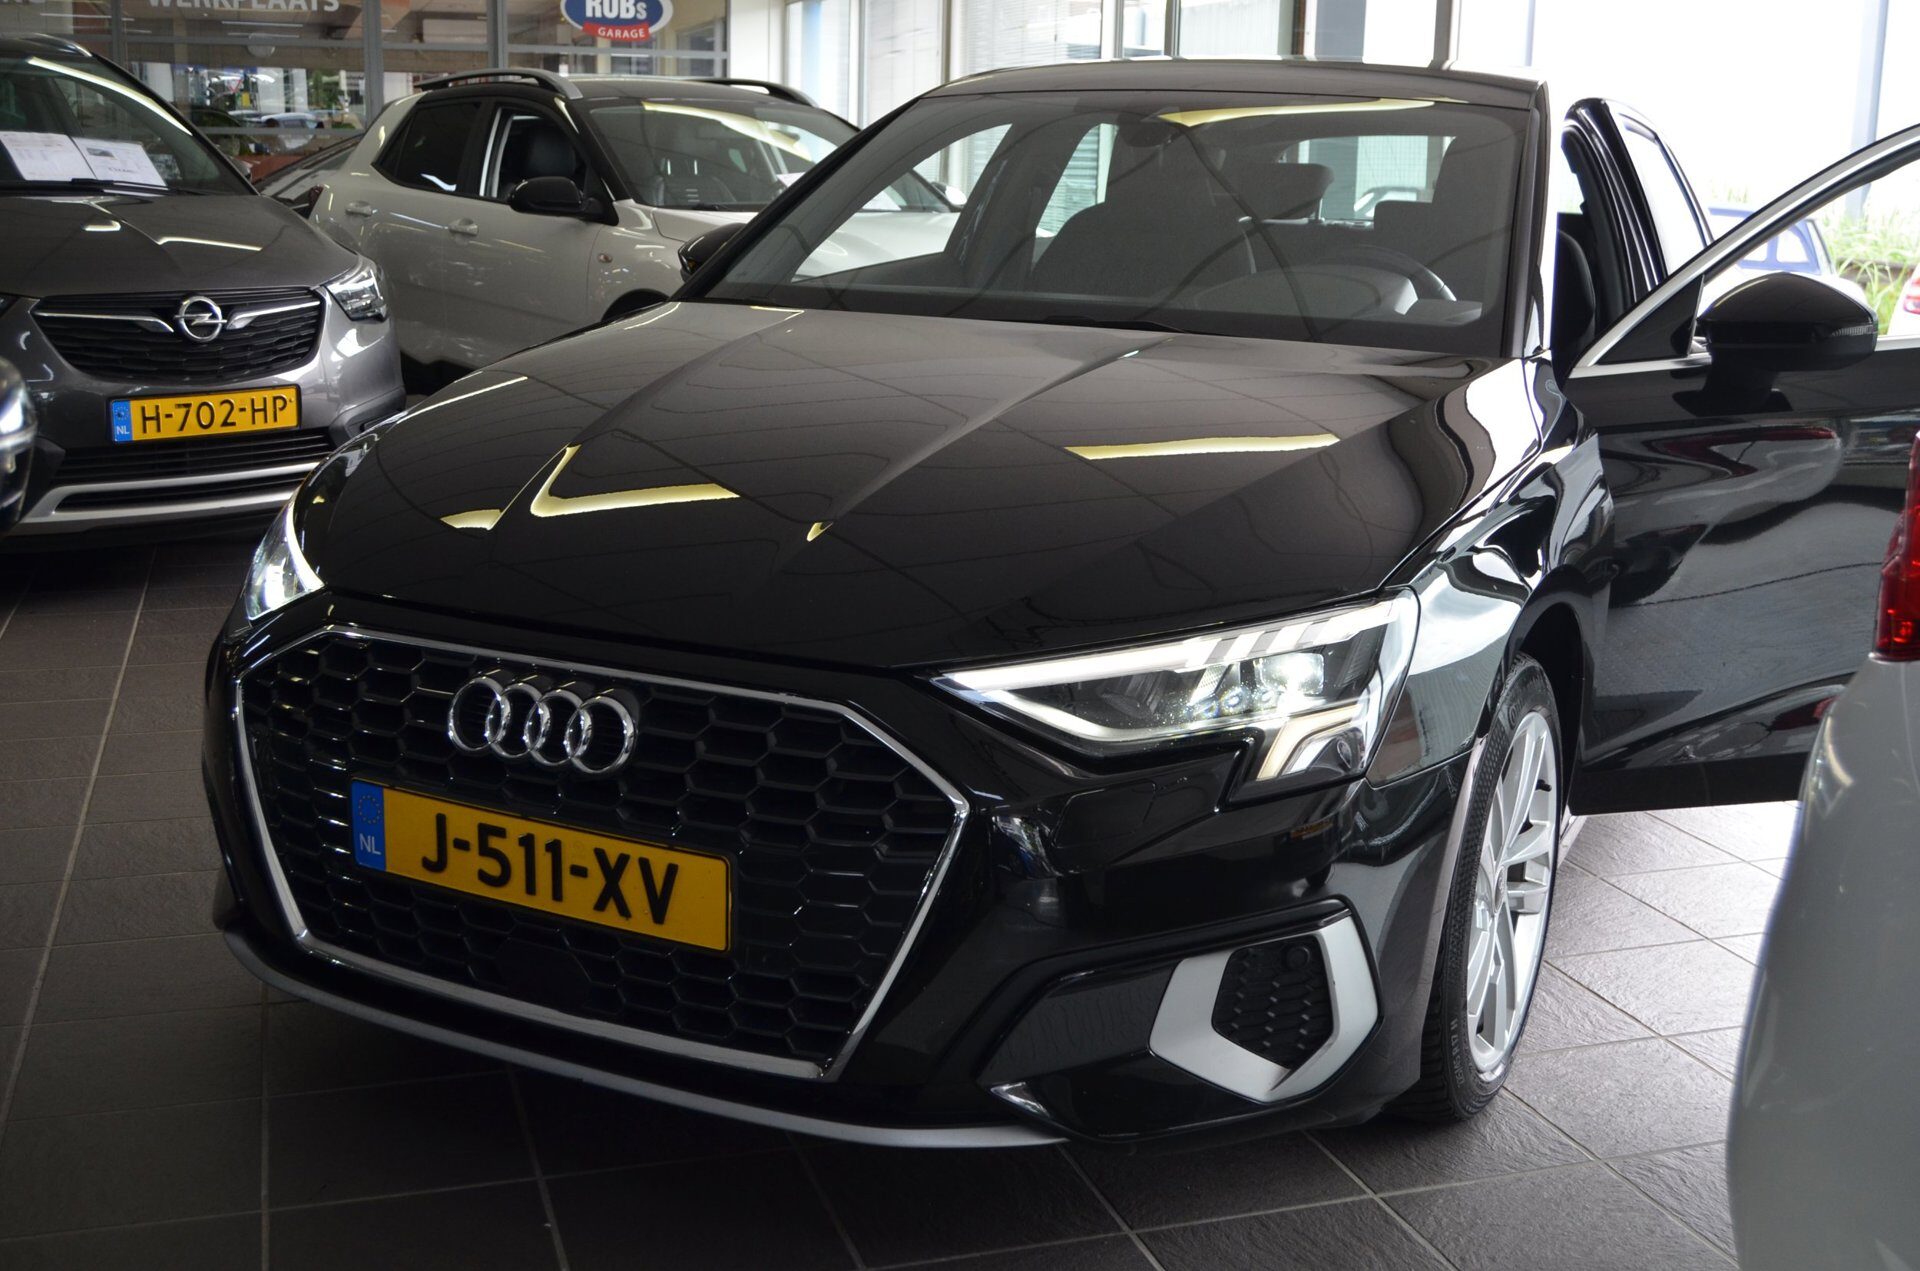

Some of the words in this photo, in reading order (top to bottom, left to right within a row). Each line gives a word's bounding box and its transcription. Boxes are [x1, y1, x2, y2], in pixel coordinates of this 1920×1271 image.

[597, 26, 646, 39] GARAGE
[140, 393, 288, 435] H-702-HP
[116, 425, 130, 436] NL
[359, 833, 382, 856] NL
[421, 812, 679, 926] J-511-XV
